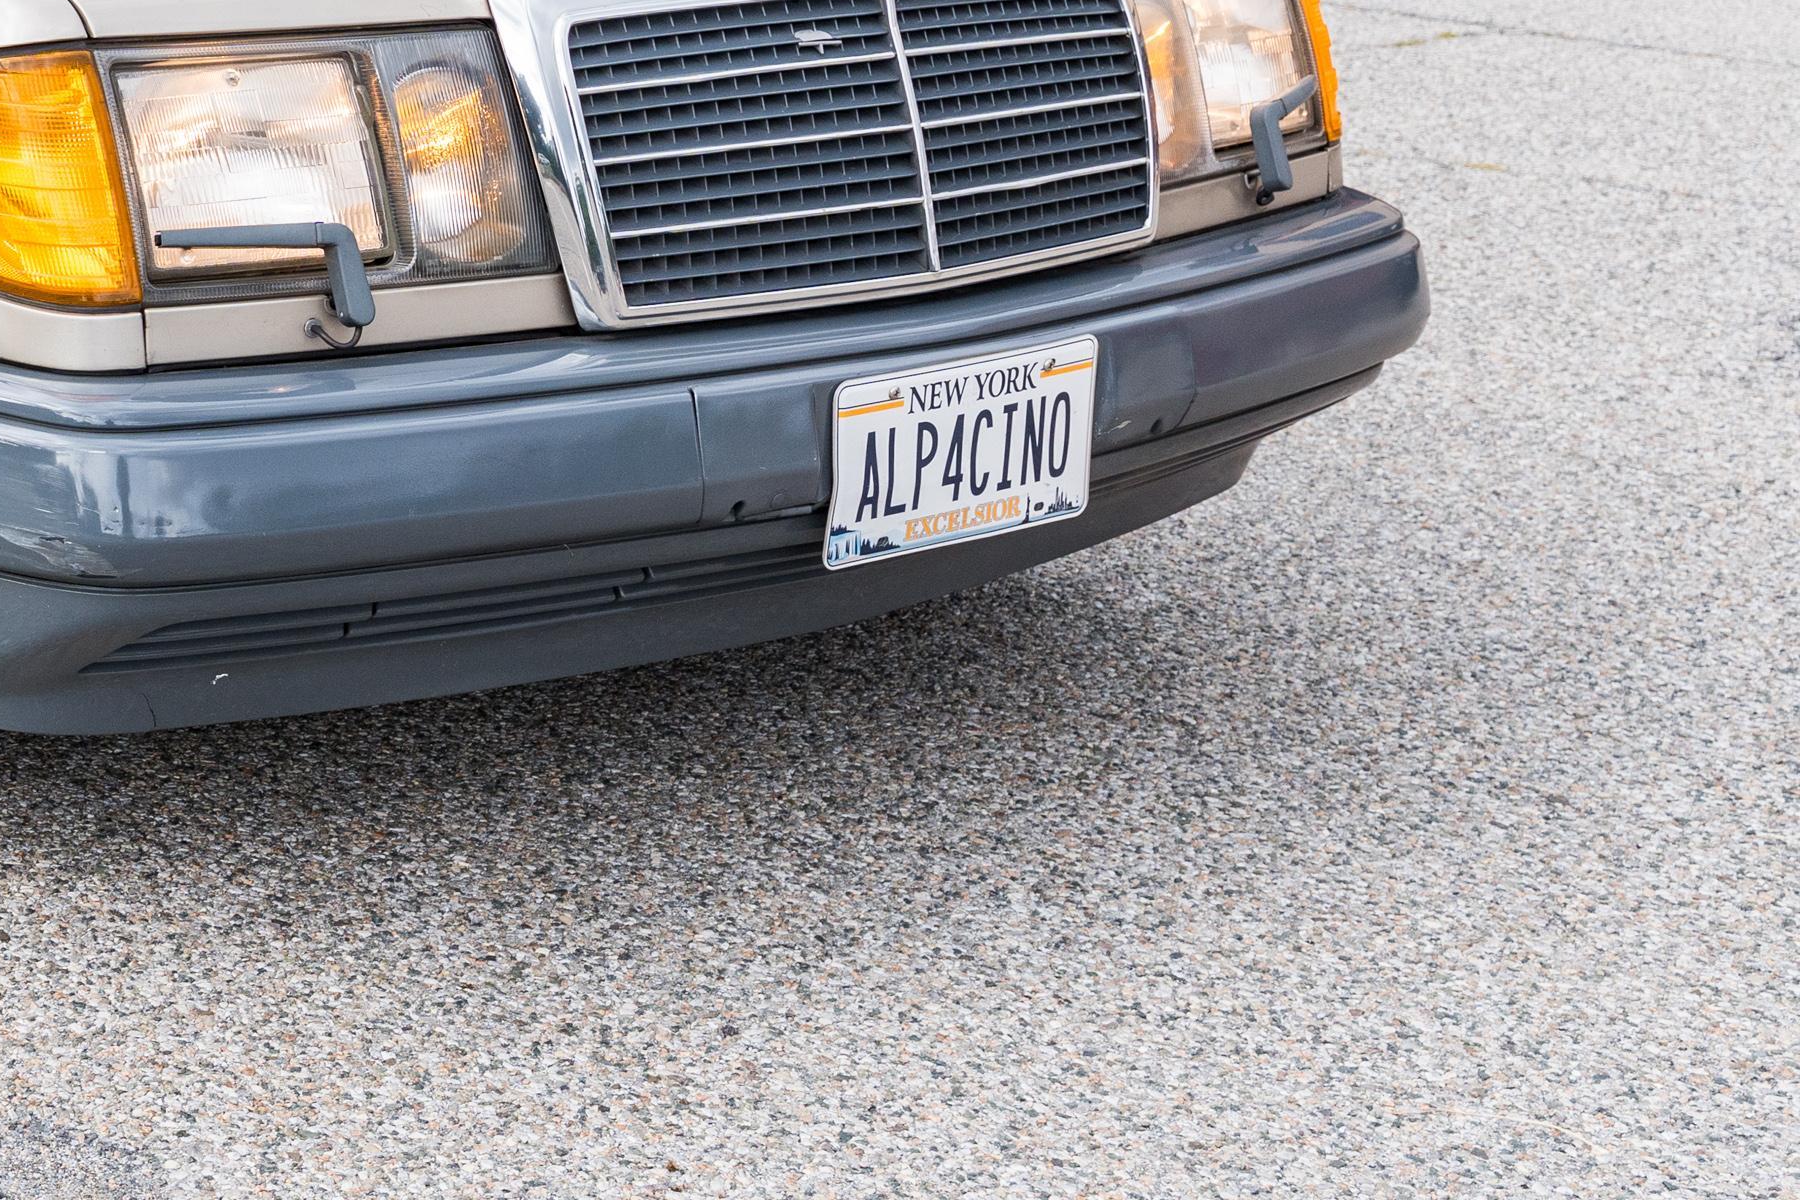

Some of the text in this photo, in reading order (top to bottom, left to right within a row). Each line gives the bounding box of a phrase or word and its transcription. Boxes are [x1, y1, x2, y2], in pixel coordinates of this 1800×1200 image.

[907, 362, 1038, 414] NEW YORK
[855, 391, 1071, 523] ALP4CINO
[903, 495, 1022, 542] EXCELSIOR
